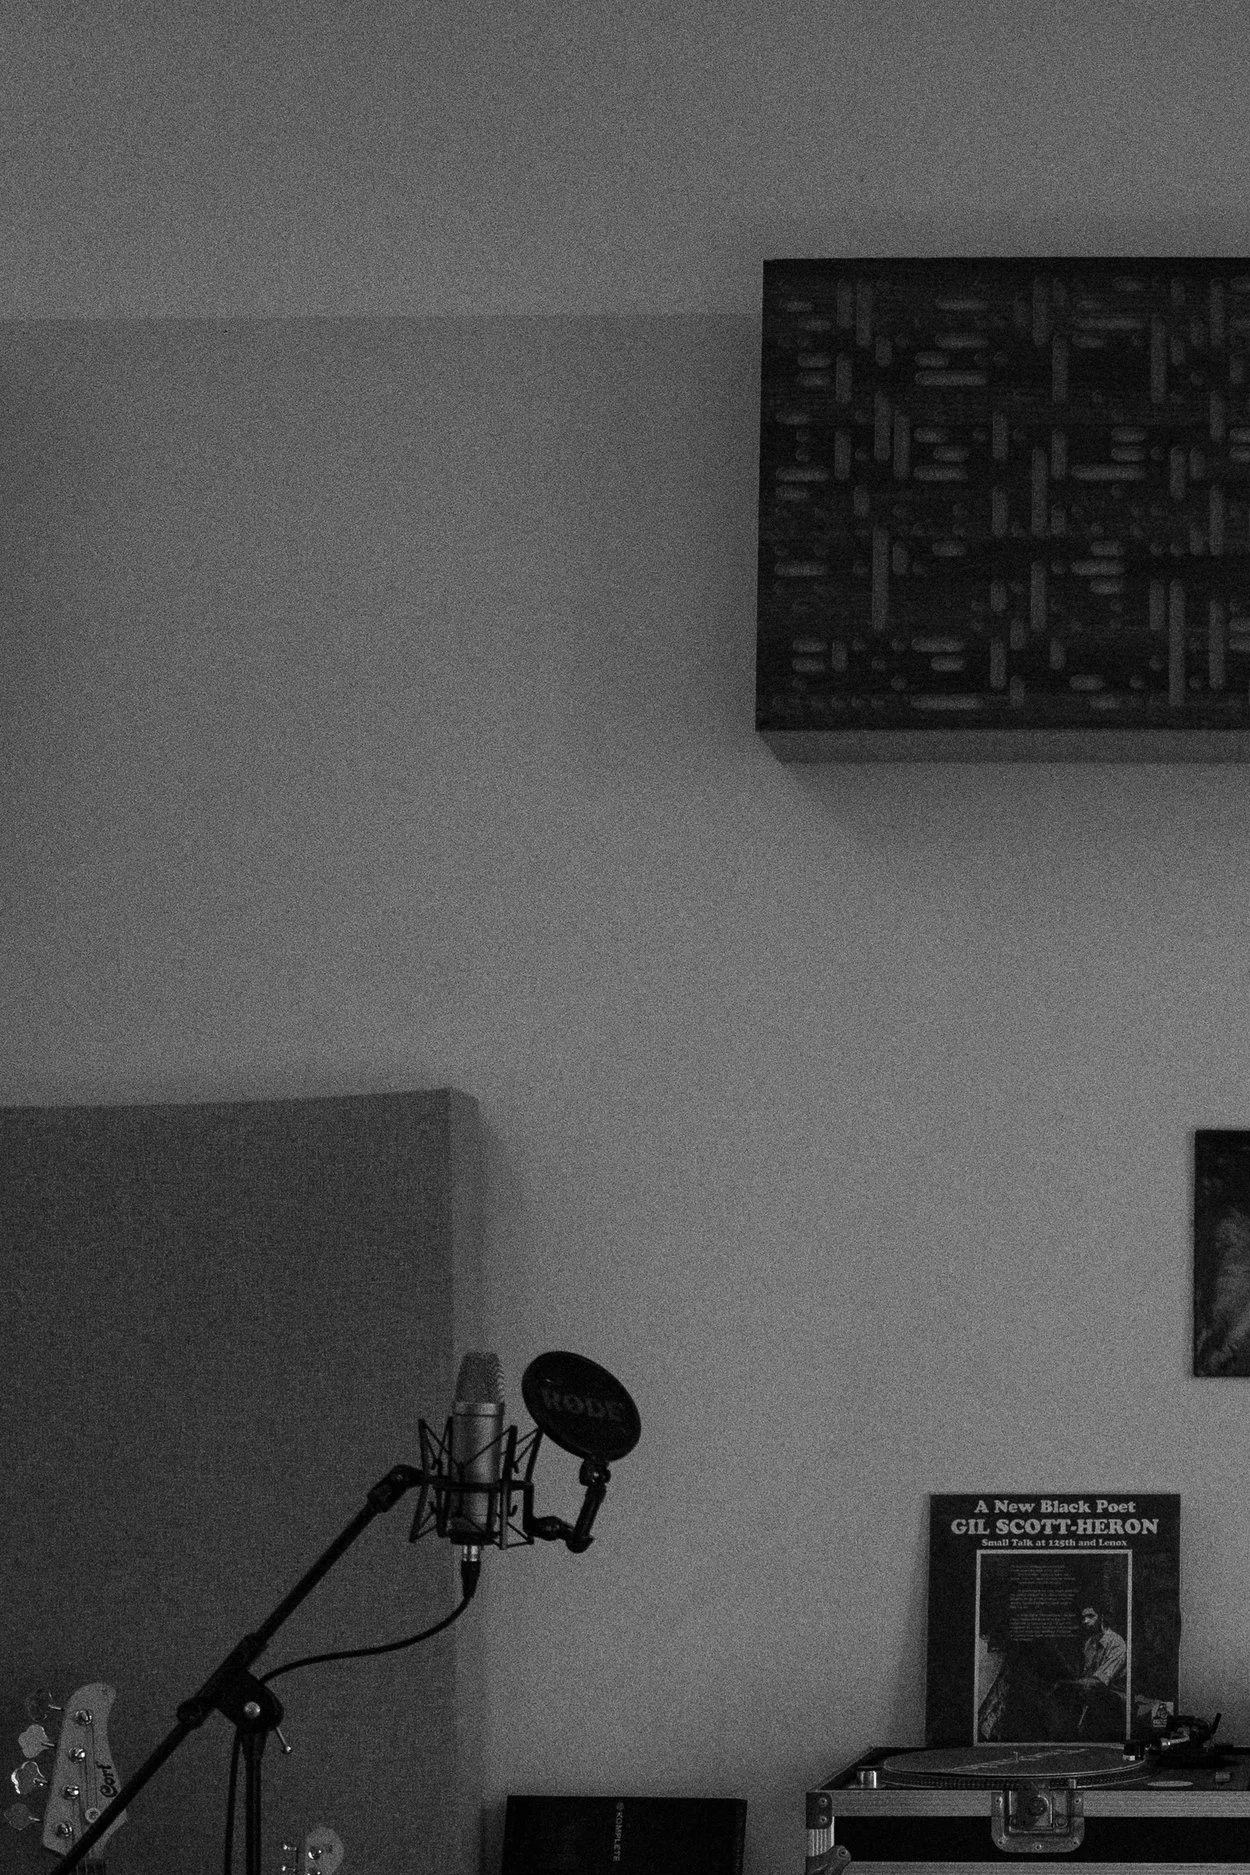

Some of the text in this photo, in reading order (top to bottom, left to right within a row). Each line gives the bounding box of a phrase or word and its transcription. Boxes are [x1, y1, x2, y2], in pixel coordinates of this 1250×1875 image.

[974, 1500, 1137, 1514] A New Black Poet
[950, 1518, 1160, 1535] GIL SCOTT-HERON
[981, 1538, 1128, 1547] Small Talk at 125th and Lenox
[95, 1761, 118, 1798] Cort
[612, 1811, 624, 1862] KOMPLETE
